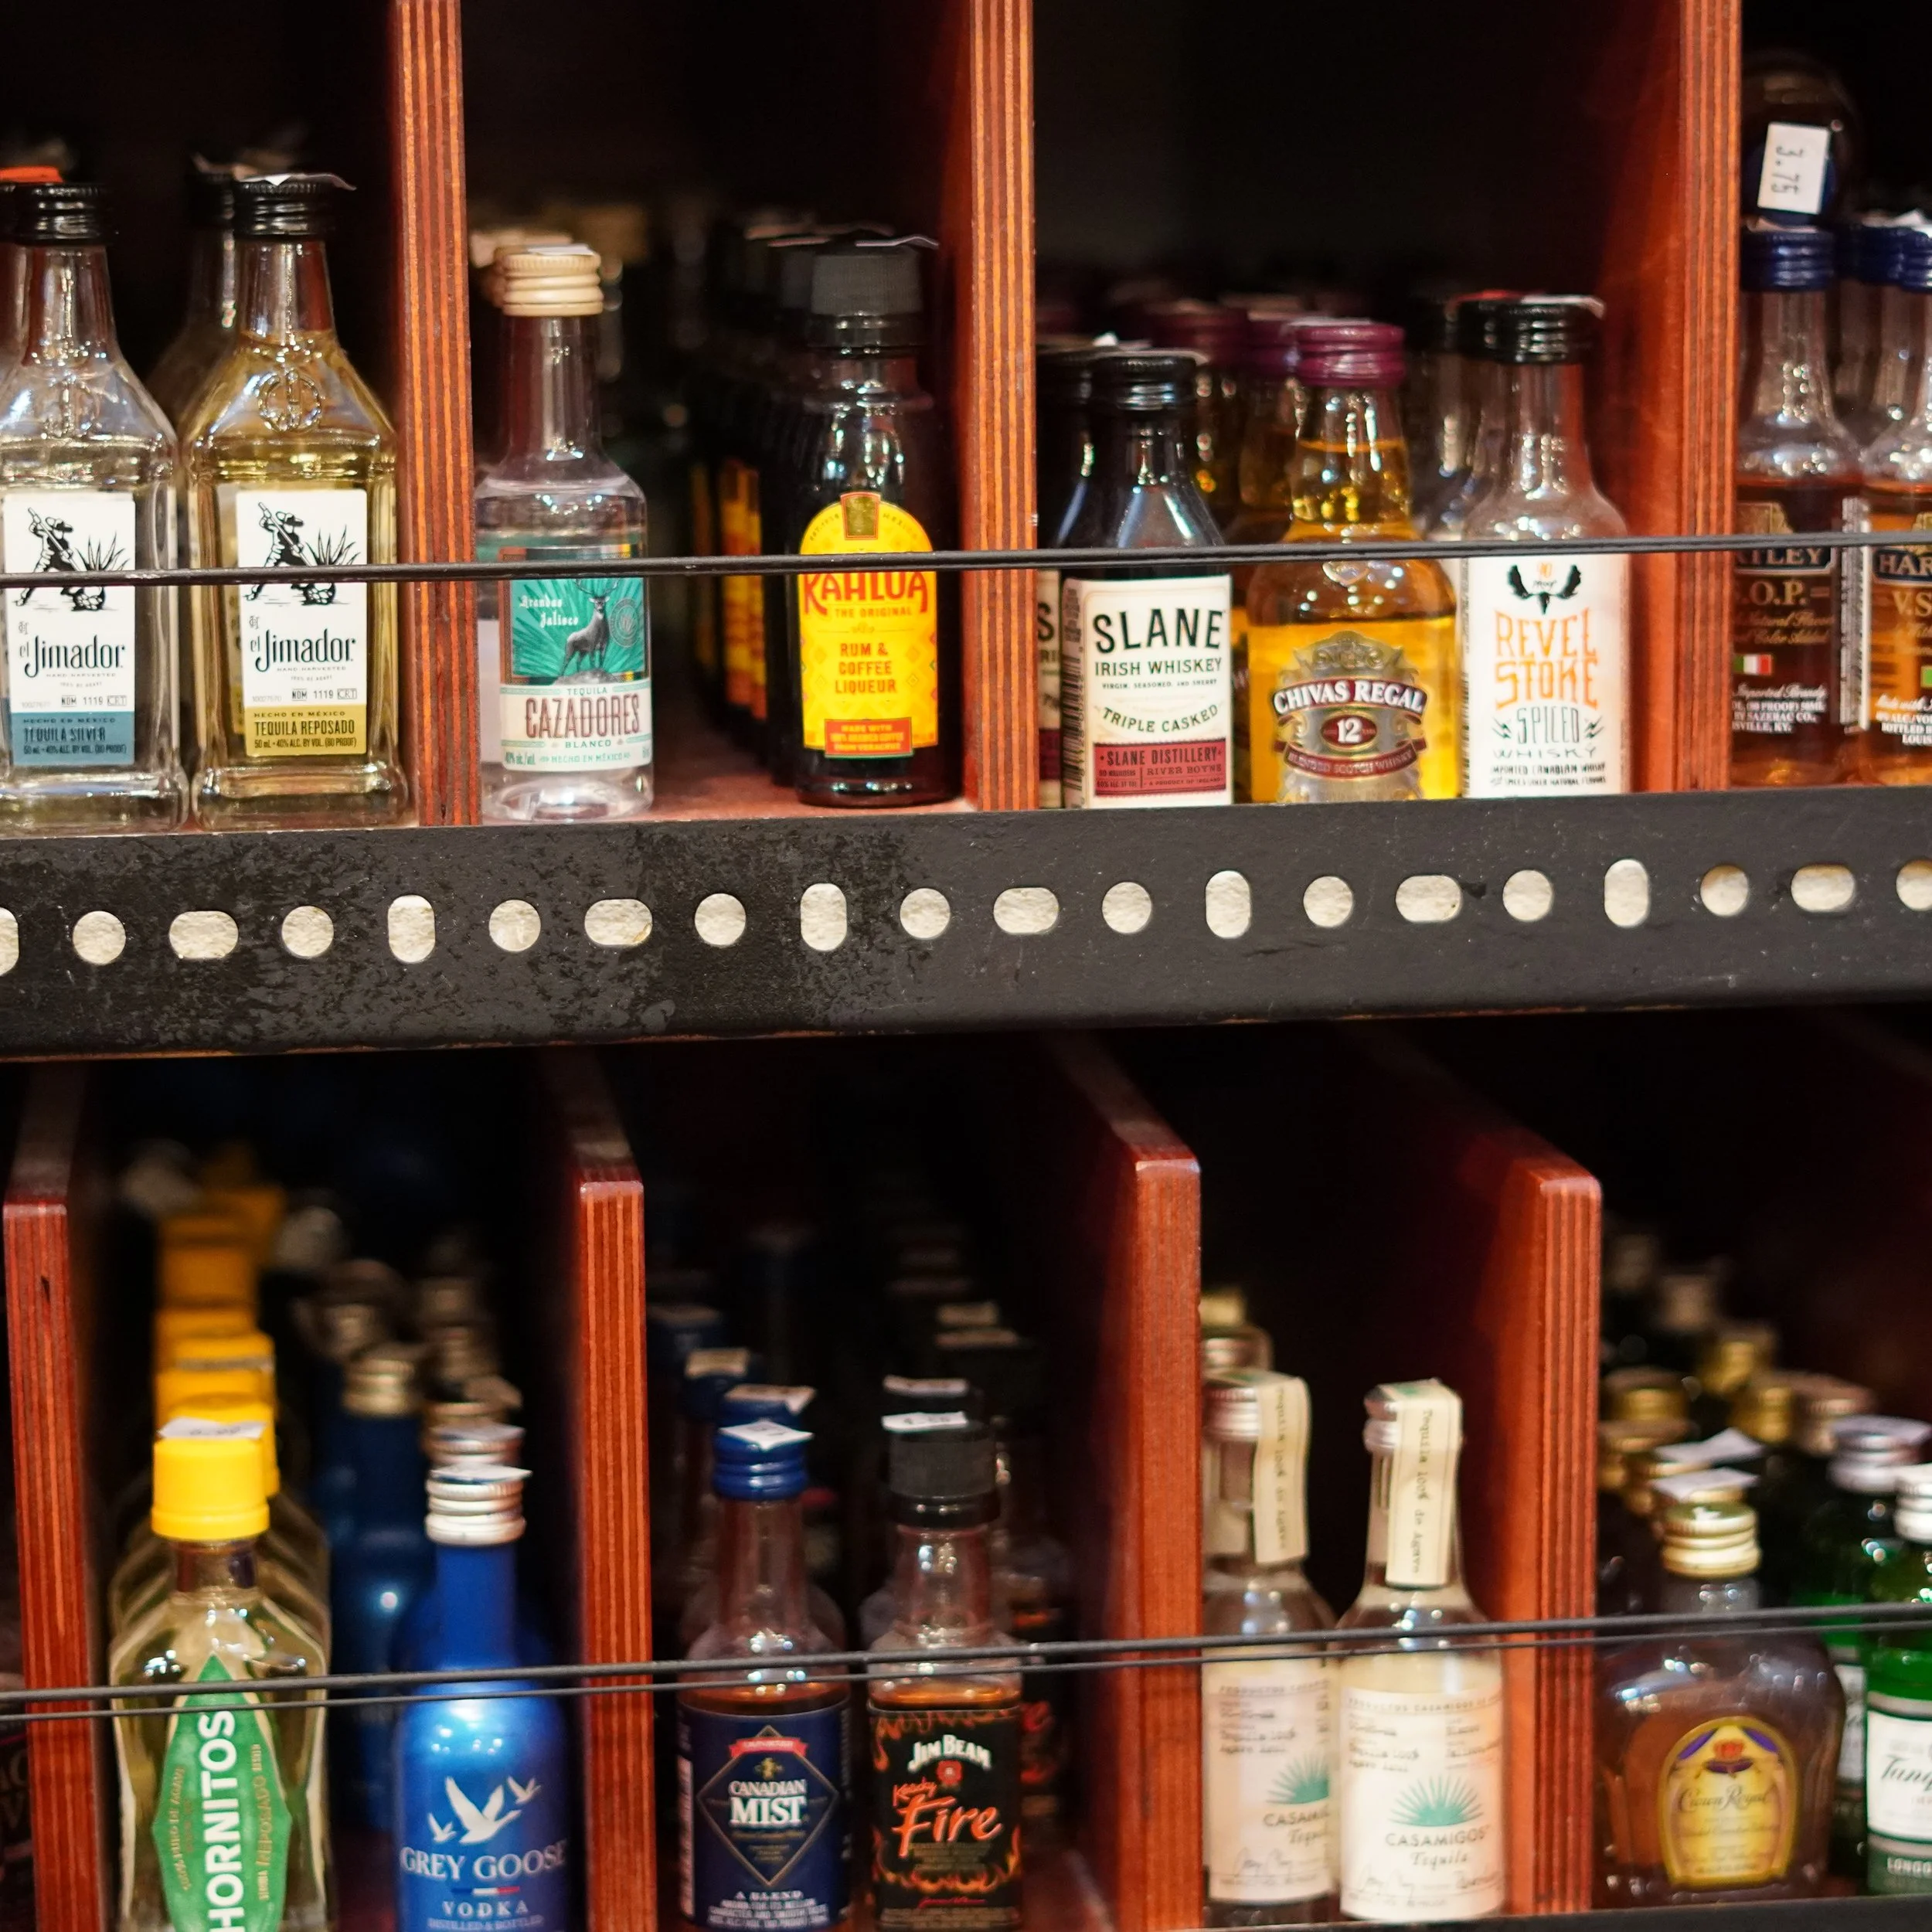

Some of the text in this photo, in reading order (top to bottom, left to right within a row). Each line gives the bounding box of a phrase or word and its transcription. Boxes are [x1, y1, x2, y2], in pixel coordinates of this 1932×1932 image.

[1770, 145, 1804, 196] 3.75
[519, 594, 563, 609] Arandas
[835, 607, 912, 617] THE ORIGINAL
[539, 610, 579, 628] Jalisco
[1092, 607, 1225, 654] SLANE
[1494, 607, 1598, 658] REVEL
[19, 634, 125, 678] el Jimador
[250, 628, 355, 672] el Jimador
[840, 642, 889, 656] RUM &
[838, 661, 893, 675] COFFEE
[1095, 657, 1223, 676] IRISH WHISKEY
[292, 690, 308, 699] NOM
[314, 689, 334, 699] 1119
[566, 686, 608, 697] TEQUILA
[835, 679, 896, 694] LIQUEUR
[1494, 658, 1599, 711] STOKE
[83, 696, 103, 705] 1119
[1274, 680, 1425, 714] CHIVAS REGAL
[525, 693, 641, 738] CAZADORES
[1101, 704, 1219, 733] TRIPLE CASKED
[1516, 706, 1580, 744] SPICED
[24, 726, 106, 742] TEQUILA SILVER
[253, 719, 355, 736] TEQUILA REPOSADO
[1337, 716, 1362, 743] 12
[254, 739, 263, 749] 50
[303, 738, 310, 747] BY
[565, 738, 612, 749] BLANCO
[1493, 746, 1597, 759] WHISKY
[551, 755, 580, 764] HECHO
[583, 754, 594, 763] EN
[1107, 746, 1218, 767] SLANE DISTILLERY
[1146, 766, 1182, 776] RIVER
[1186, 763, 1222, 774] BOYNE
[1332, 762, 1374, 774] SCOTCH
[1417, 1409, 1434, 1464] Tequila
[1416, 1470, 1430, 1500] 100%
[1411, 1532, 1425, 1573] Agave
[907, 1734, 992, 1772] JIM BEAM
[727, 1779, 808, 1797] CANADIAN
[1677, 1784, 1770, 1813] Crown Royal
[197, 1709, 246, 1932] HORNITOS
[252, 1774, 274, 1866] REPOSADO
[729, 1795, 808, 1828] MIST
[891, 1793, 1003, 1859] Fire
[1385, 1826, 1485, 1847] CASAMIGOS
[400, 1846, 465, 1881] GREY
[1411, 1850, 1468, 1871] Tequila
[735, 1890, 804, 1901] A BLEND
[441, 1899, 529, 1918] VODKA
[427, 1917, 482, 1930] DISTILLED
